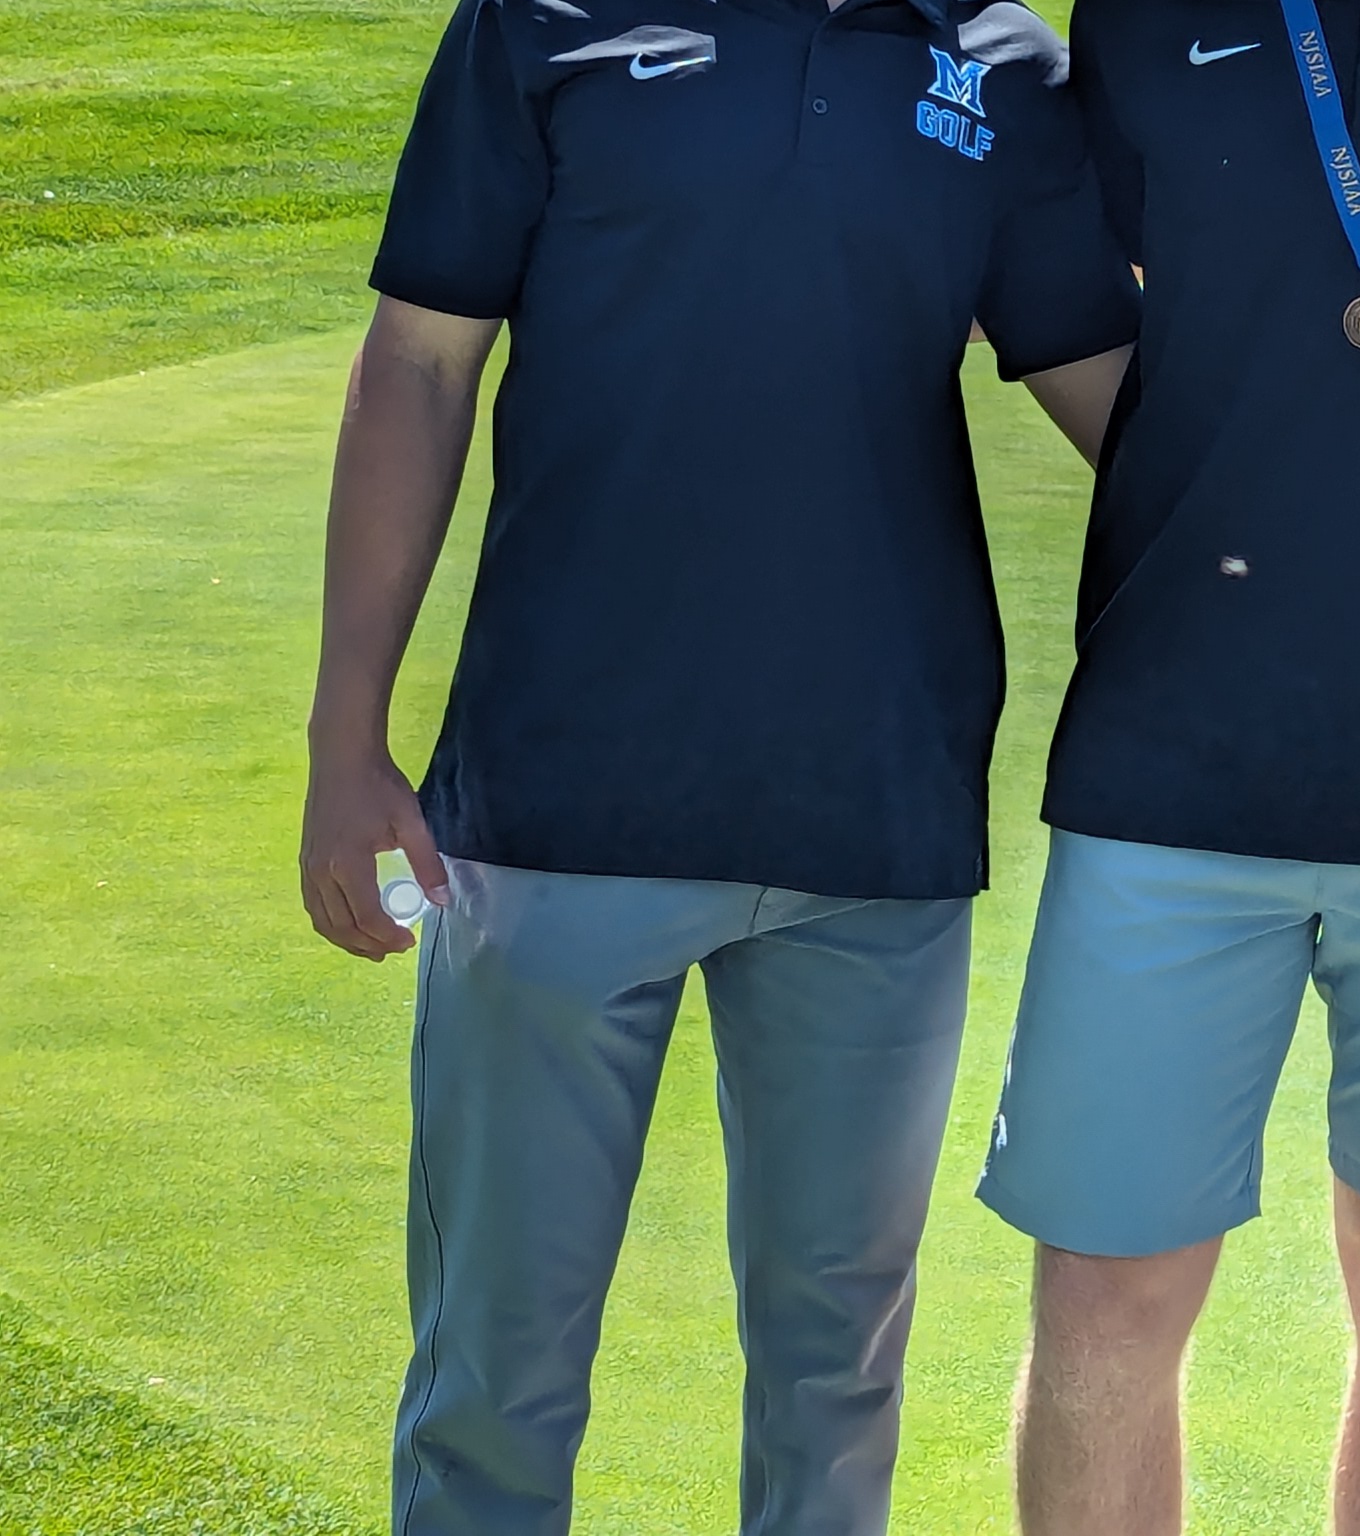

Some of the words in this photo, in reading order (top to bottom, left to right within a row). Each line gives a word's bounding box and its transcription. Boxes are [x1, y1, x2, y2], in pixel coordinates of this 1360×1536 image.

[927, 43, 992, 118] M
[1298, 29, 1333, 98] NJSIAA
[916, 100, 996, 161] GOLF
